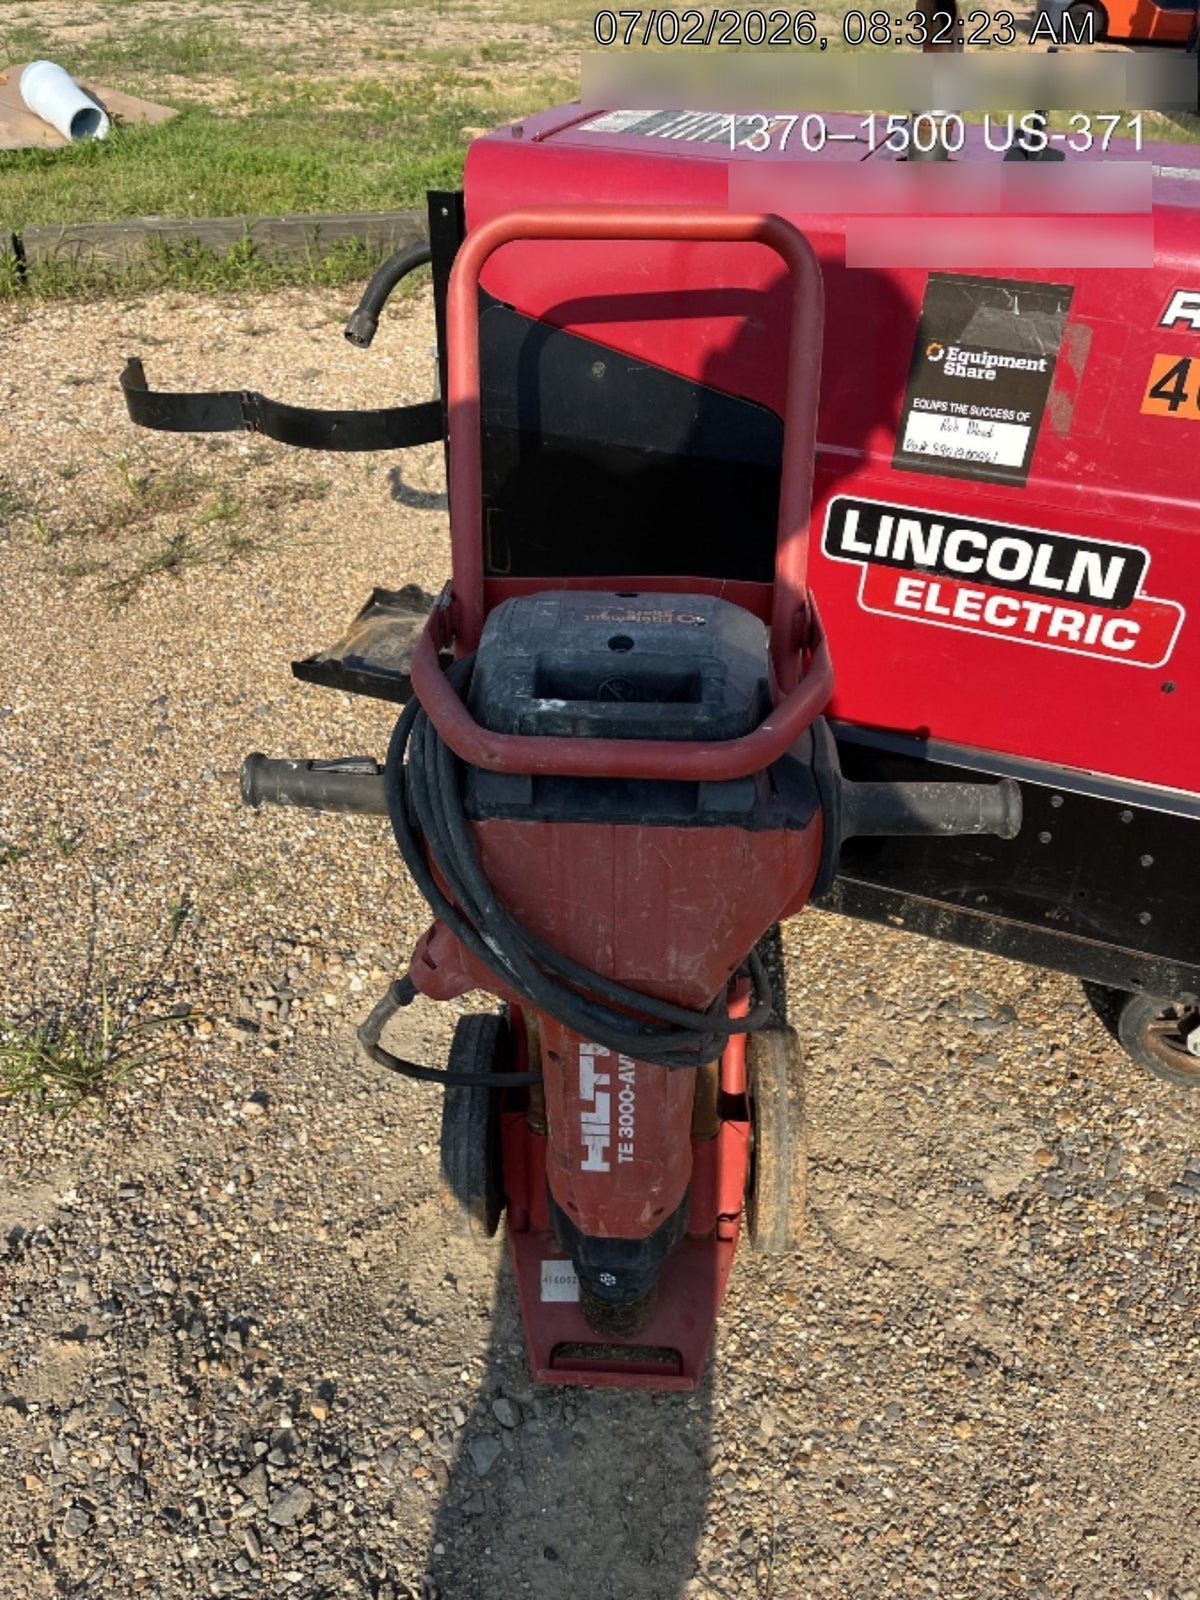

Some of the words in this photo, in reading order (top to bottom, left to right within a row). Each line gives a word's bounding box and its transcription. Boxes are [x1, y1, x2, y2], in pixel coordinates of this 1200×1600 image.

[943, 361, 997, 381] Share
[946, 345, 1048, 373] Equipment
[1149, 357, 1200, 411] 4
[913, 397, 948, 414] EQUIPS
[949, 401, 969, 416] THE
[970, 405, 1015, 421] SUCCESS
[1016, 409, 1031, 422] OF
[840, 509, 1126, 600] LINCOLN
[894, 577, 1141, 652] ELECTRIC
[617, 1053, 637, 1138] 3000-AV
[617, 1139, 634, 1163] TE
